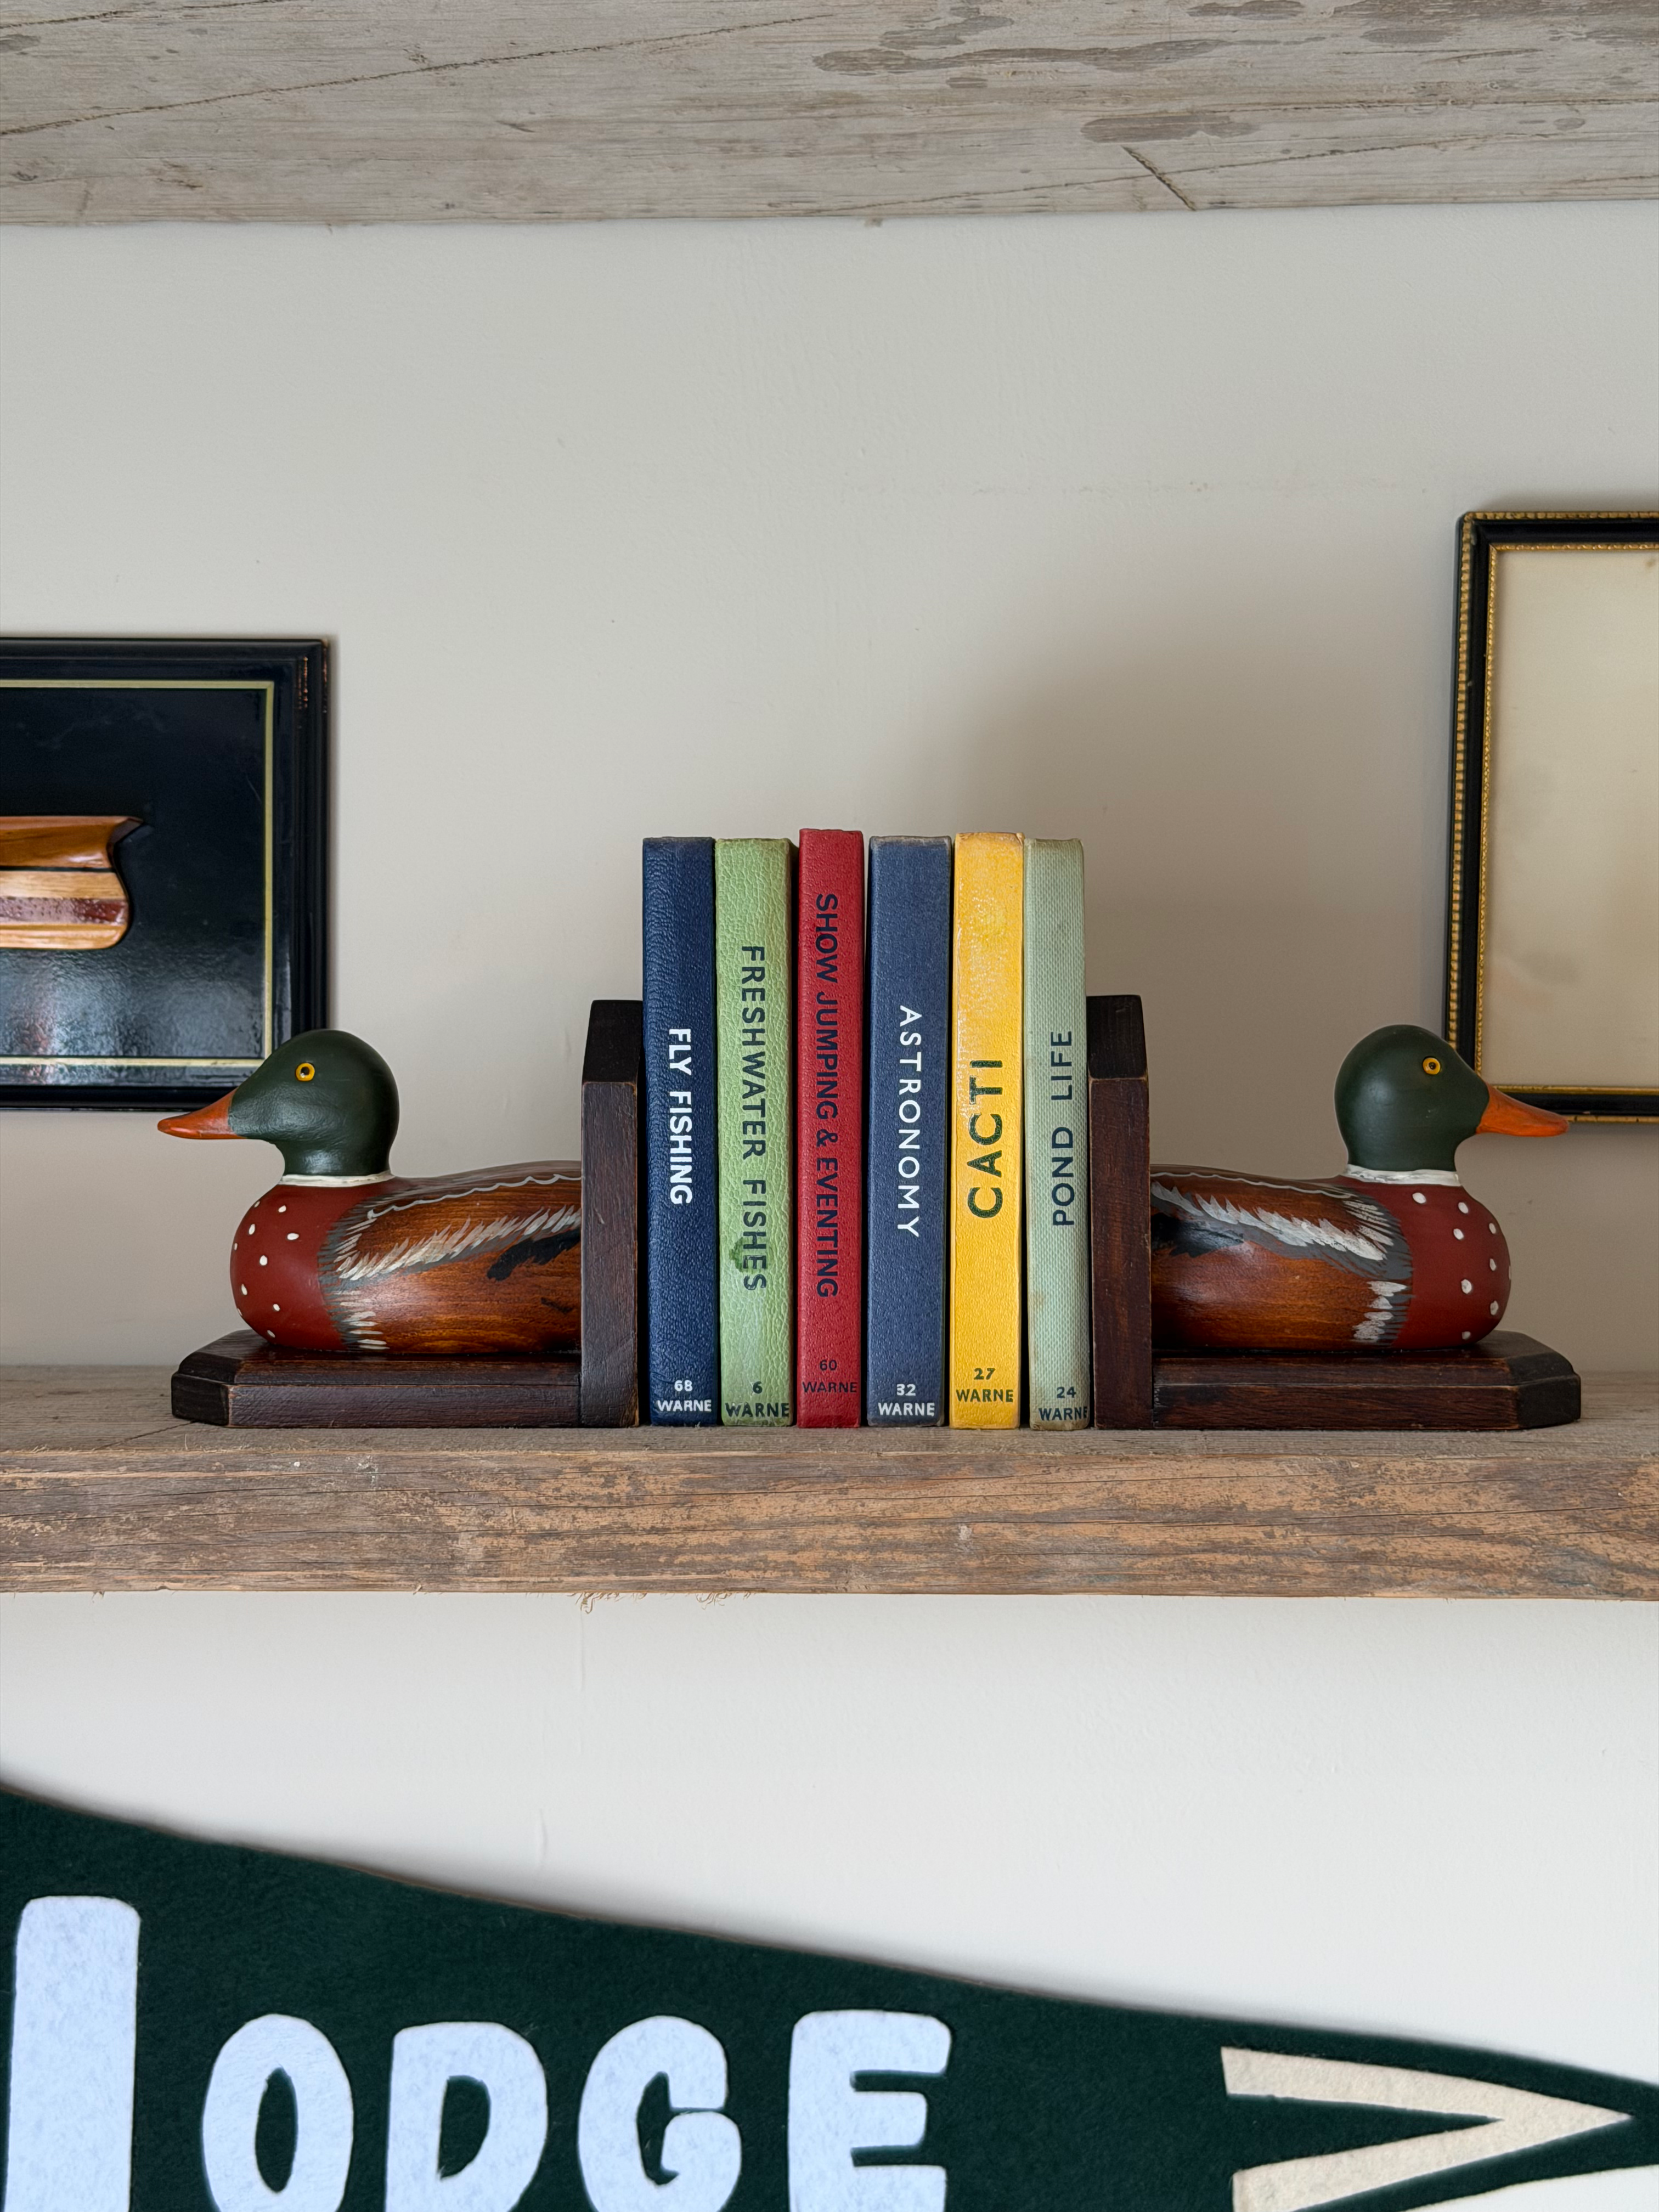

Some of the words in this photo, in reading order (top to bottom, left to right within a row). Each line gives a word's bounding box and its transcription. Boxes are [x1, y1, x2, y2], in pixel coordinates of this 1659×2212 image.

[815, 894, 838, 984] SHOW
[669, 1028, 692, 1076] FLY
[741, 946, 766, 1160] FRESHWATER
[816, 991, 838, 1120] JUMPING
[1051, 1031, 1073, 1101] LIFE
[897, 1005, 922, 1237] ASTRONOMY
[816, 1128, 838, 1148] &
[967, 1060, 1003, 1218] CACTI
[669, 1091, 693, 1205] FISHING
[1051, 1126, 1075, 1226] POND
[741, 1179, 768, 1291] FISHES
[816, 1158, 838, 1297] EVENTING
[819, 1359, 838, 1372] 60
[973, 1368, 996, 1380] 27
[674, 1379, 693, 1392] 68
[752, 1381, 763, 1394] 6
[802, 1381, 858, 1395] WARNE
[896, 1384, 916, 1396] 32
[1056, 1386, 1077, 1399] 24
[956, 1389, 1013, 1403] WARNE
[657, 1400, 712, 1412] WARNE
[725, 1402, 790, 1418] WARNE
[878, 1402, 935, 1417] WARNE
[1038, 1405, 1088, 1421] WARNE
